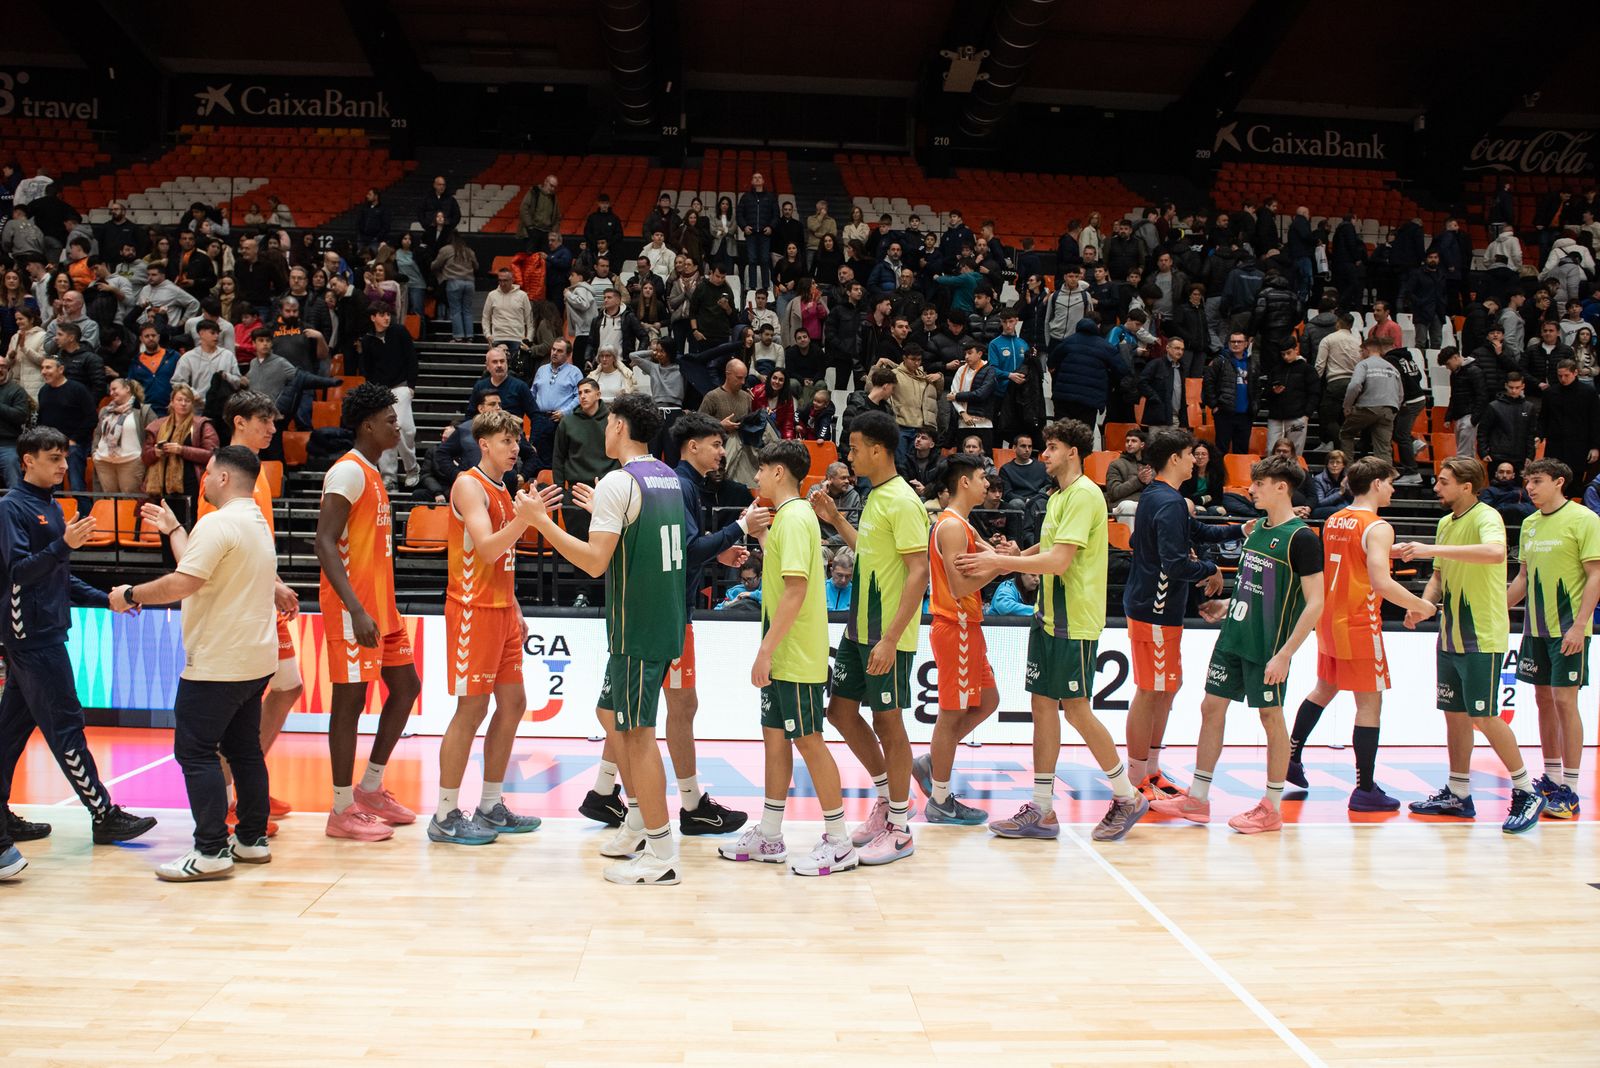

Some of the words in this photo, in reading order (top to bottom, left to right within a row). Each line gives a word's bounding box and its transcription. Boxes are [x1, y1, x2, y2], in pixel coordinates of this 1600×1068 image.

[22, 97, 98, 119] travel
[240, 86, 390, 118] CaixaBank
[391, 119, 407, 128] 213
[662, 126, 678, 136] 212
[934, 136, 950, 146] 210
[1195, 150, 1211, 159] 209
[1246, 124, 1386, 160] CaixaBank
[1468, 129, 1594, 174] oca-Cola
[660, 524, 683, 572] 14
[1330, 553, 1342, 592] 7
